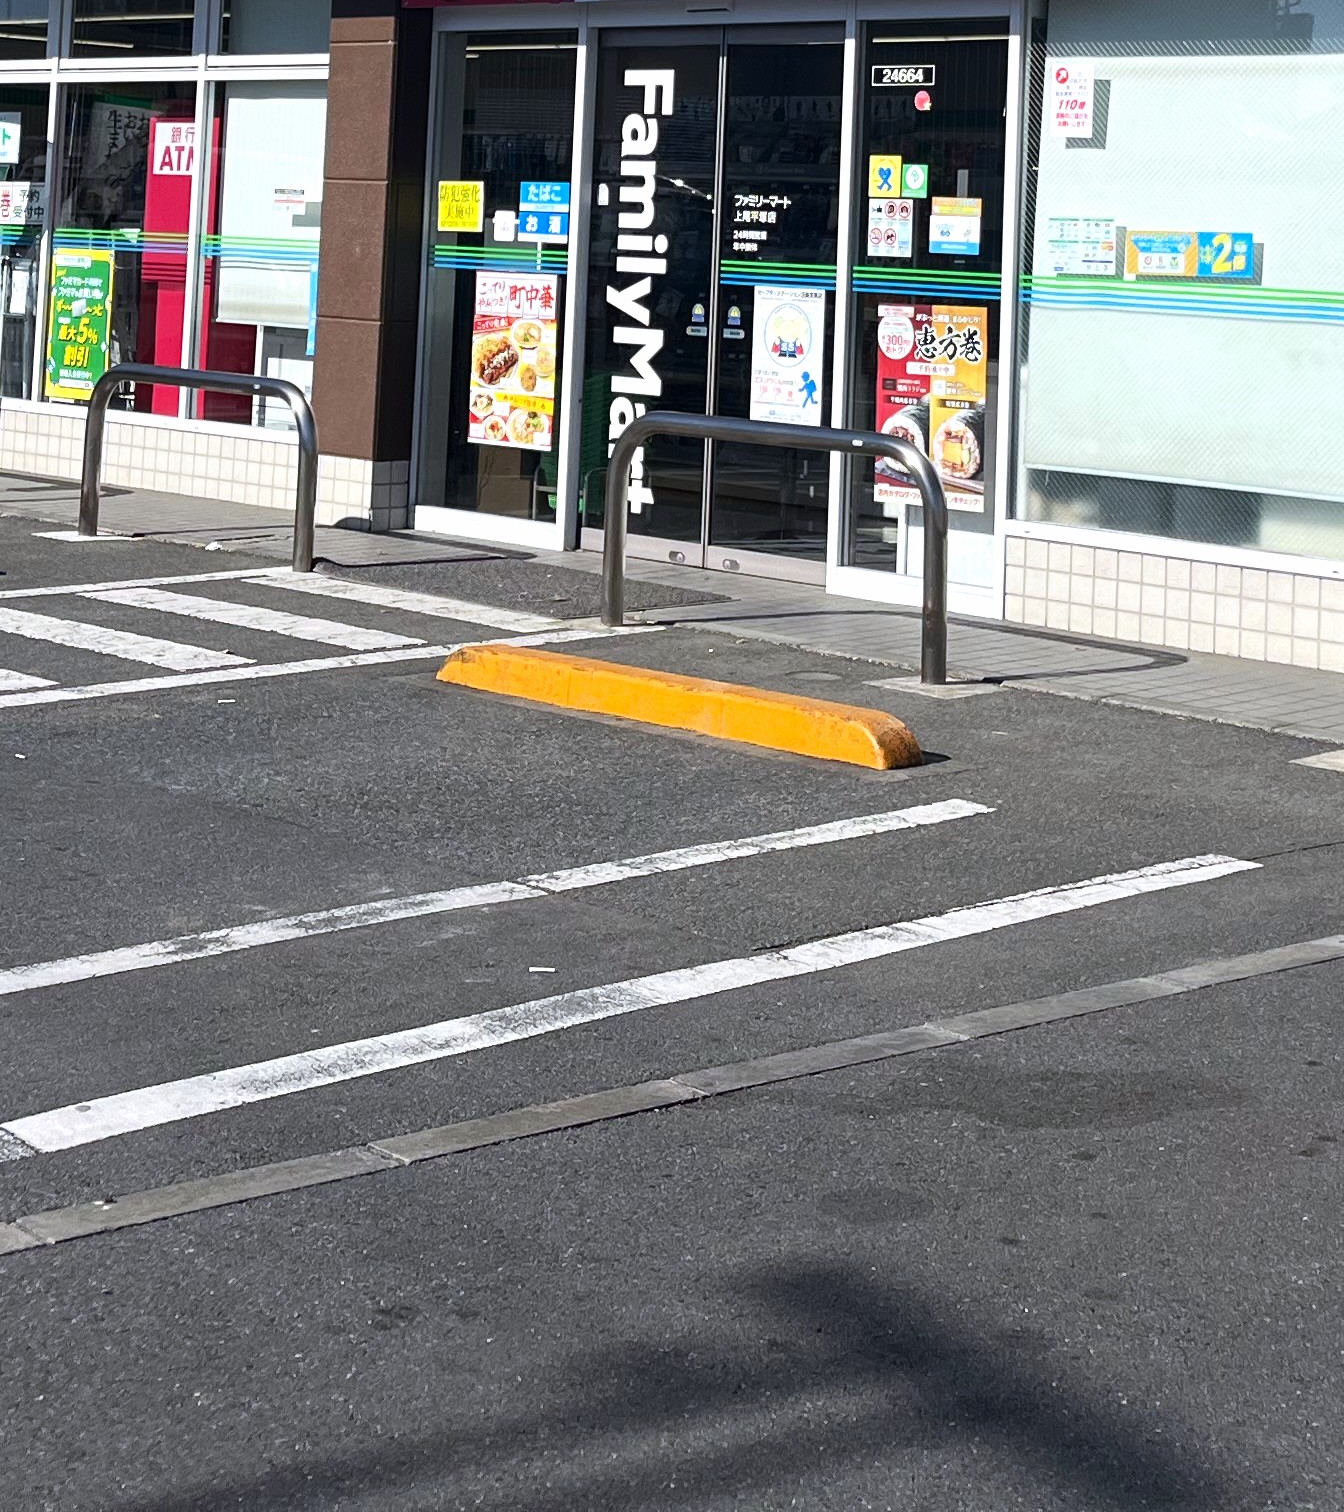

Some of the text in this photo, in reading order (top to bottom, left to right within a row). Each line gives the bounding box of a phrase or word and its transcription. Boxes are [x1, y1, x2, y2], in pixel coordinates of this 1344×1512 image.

[882, 68, 924, 83] 24664
[171, 127, 195, 143] 銀行
[527, 185, 562, 202] たばこ
[734, 194, 792, 209] ファミリーマート
[509, 285, 554, 311] 町中華
[915, 325, 982, 362] 恵方巻
[64, 345, 89, 368] 割引
